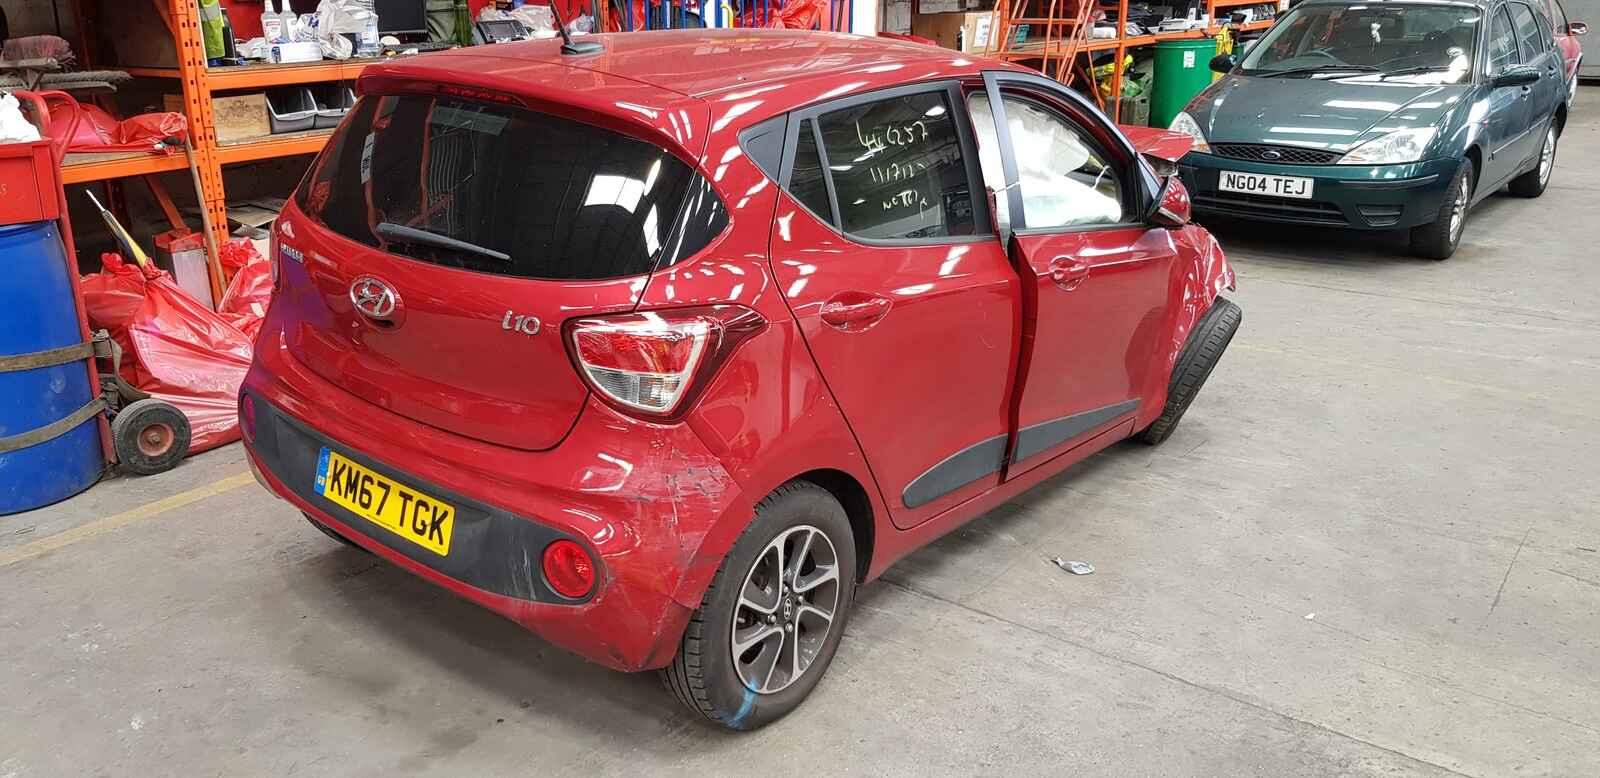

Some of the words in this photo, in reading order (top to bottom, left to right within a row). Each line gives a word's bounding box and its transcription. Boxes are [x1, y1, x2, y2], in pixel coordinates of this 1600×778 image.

[1226, 173, 1267, 192] NG04
[1273, 178, 1306, 195] TEJ
[502, 310, 540, 335] i10
[330, 459, 391, 516] KM67
[398, 490, 449, 546] TGK
